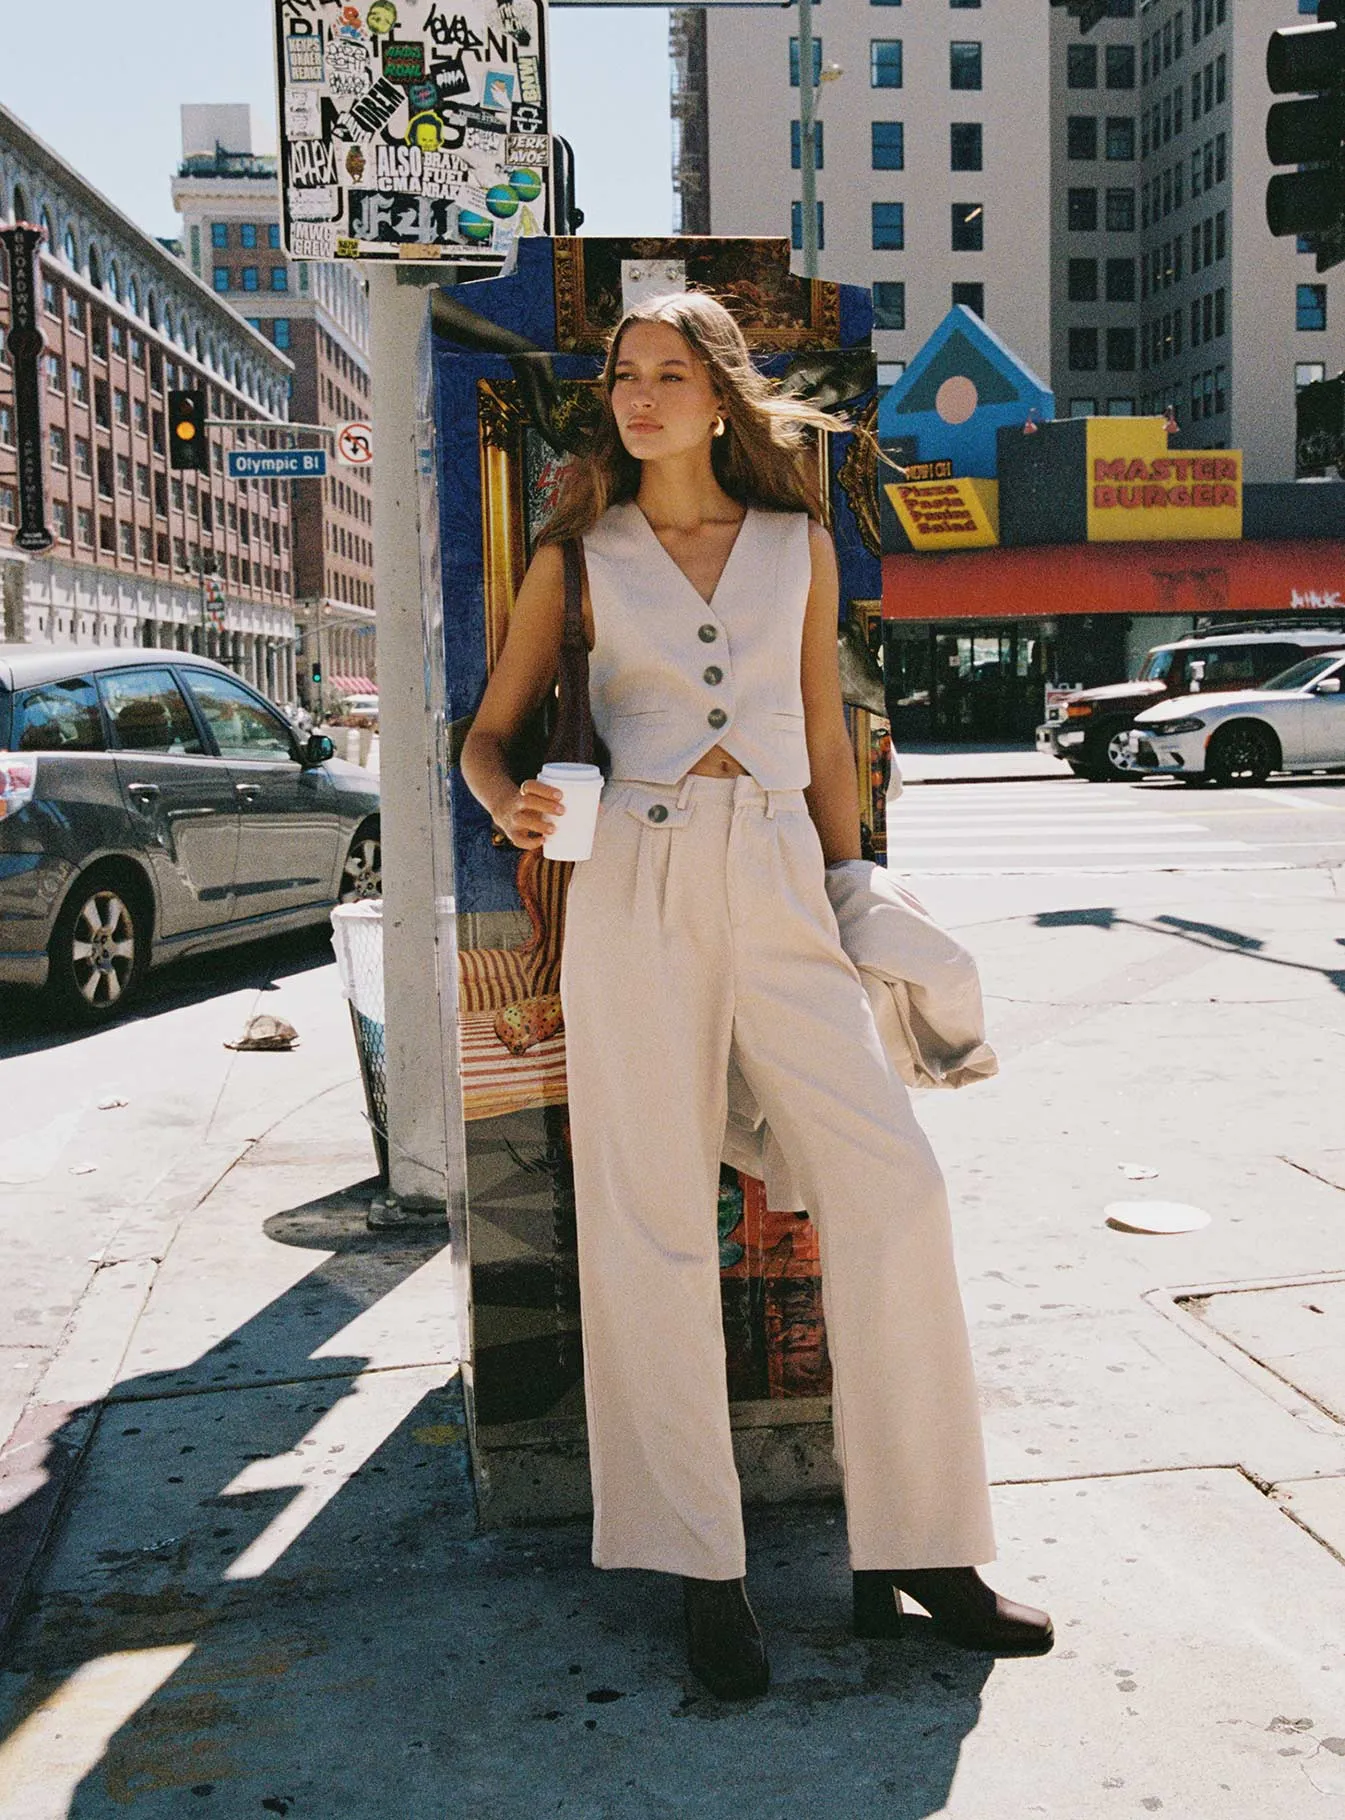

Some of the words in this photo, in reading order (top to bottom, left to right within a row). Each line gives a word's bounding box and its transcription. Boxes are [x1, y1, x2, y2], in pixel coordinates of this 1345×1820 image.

[378, 145, 422, 177] ALSO
[236, 456, 298, 474] Olympic
[1094, 456, 1237, 482] MASTER
[1094, 483, 1237, 509] BURGER
[918, 519, 979, 534] Salad
